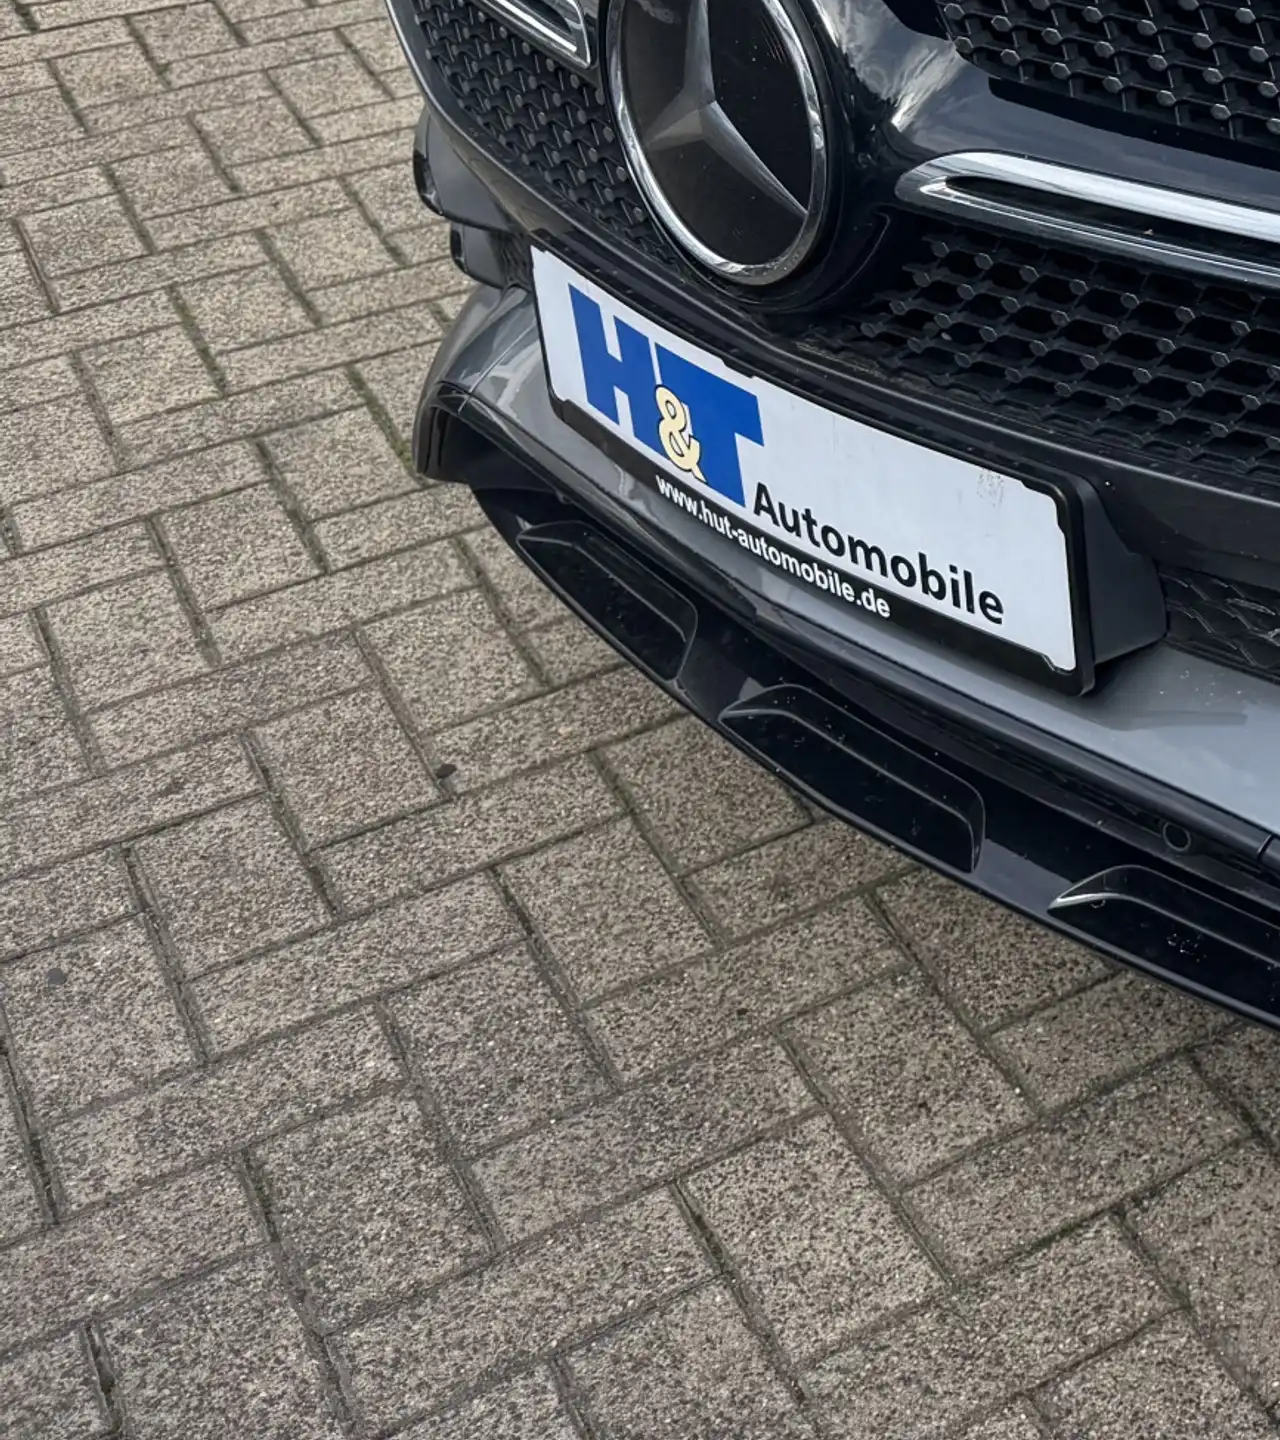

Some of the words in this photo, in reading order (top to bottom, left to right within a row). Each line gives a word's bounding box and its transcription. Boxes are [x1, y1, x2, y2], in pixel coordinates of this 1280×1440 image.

[568, 283, 765, 508] H&T
[753, 482, 1005, 625] Automobile
[655, 474, 891, 619] www.hut-automobile.de
